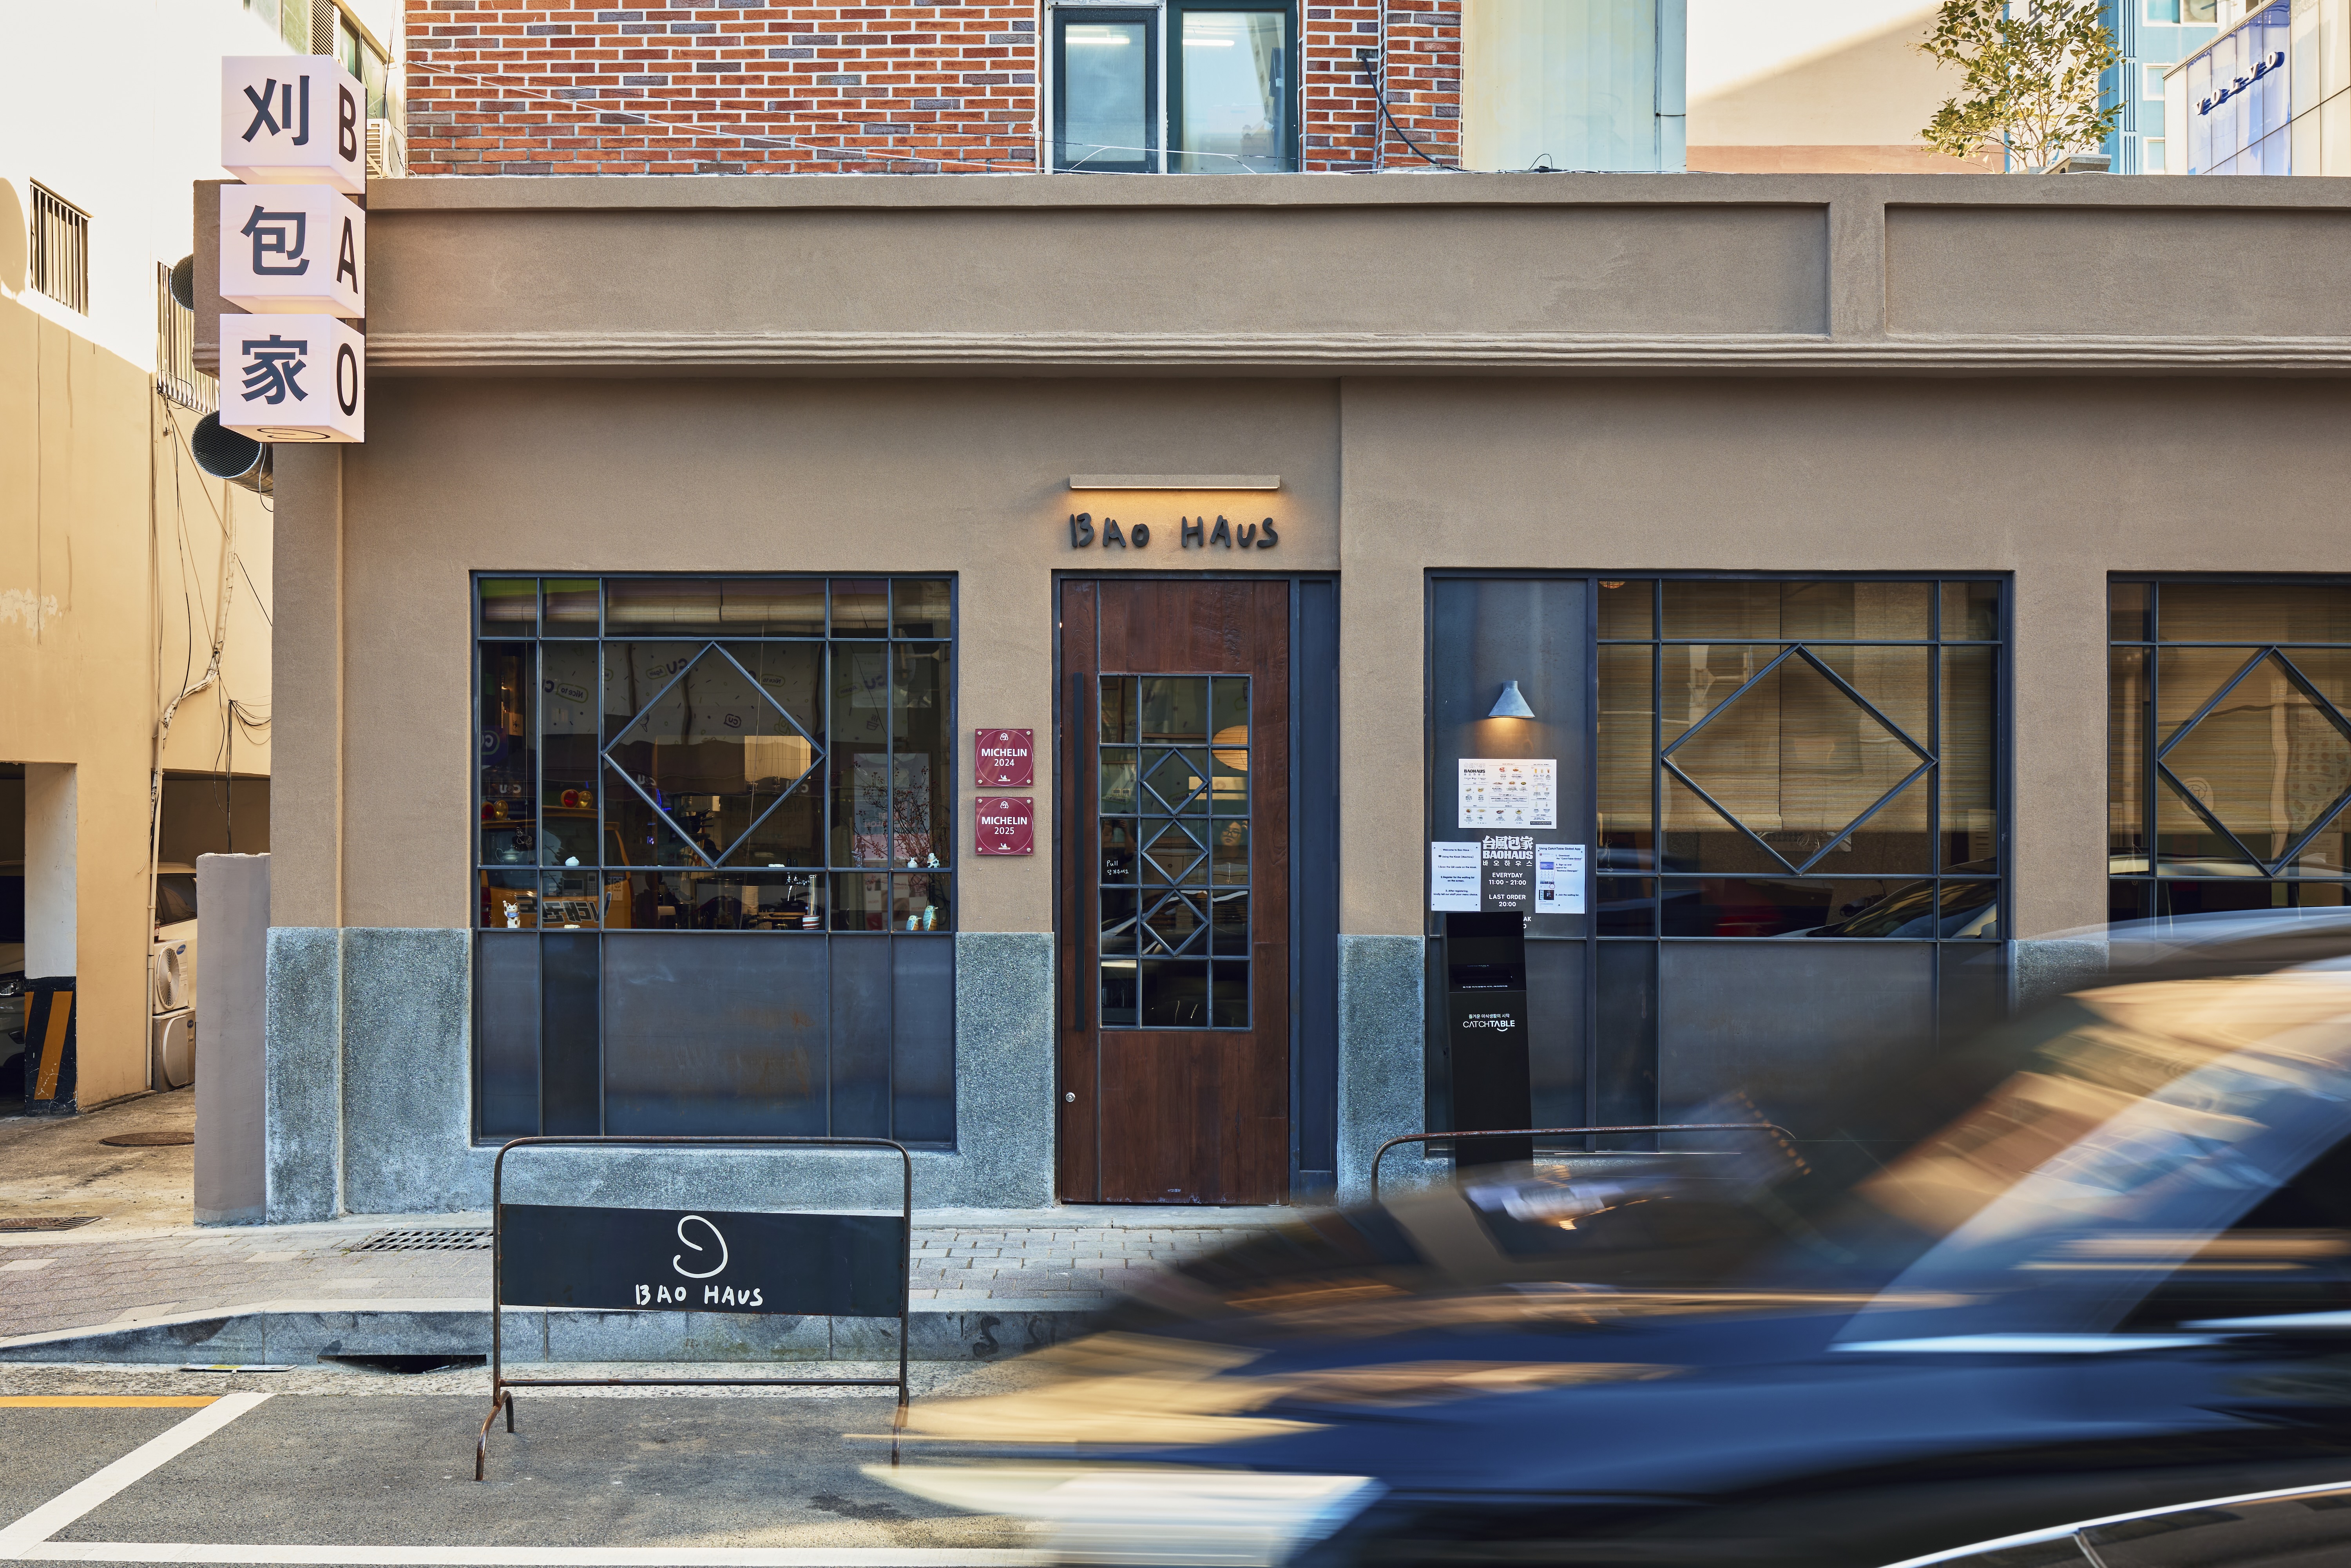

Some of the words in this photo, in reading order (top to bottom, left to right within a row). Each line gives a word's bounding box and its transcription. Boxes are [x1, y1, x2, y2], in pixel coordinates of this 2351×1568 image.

[2192, 51, 2278, 115] VOLVO
[1070, 512, 1150, 547] BAO
[1181, 515, 1278, 547] HAUS
[982, 748, 1027, 757] MICHELIN
[982, 817, 1027, 825] MICHELIN
[1482, 835, 1534, 850] 台風包家
[1482, 851, 1533, 860] BAOHAUS
[636, 1284, 686, 1305] BAO
[705, 1284, 763, 1306] HAUS
